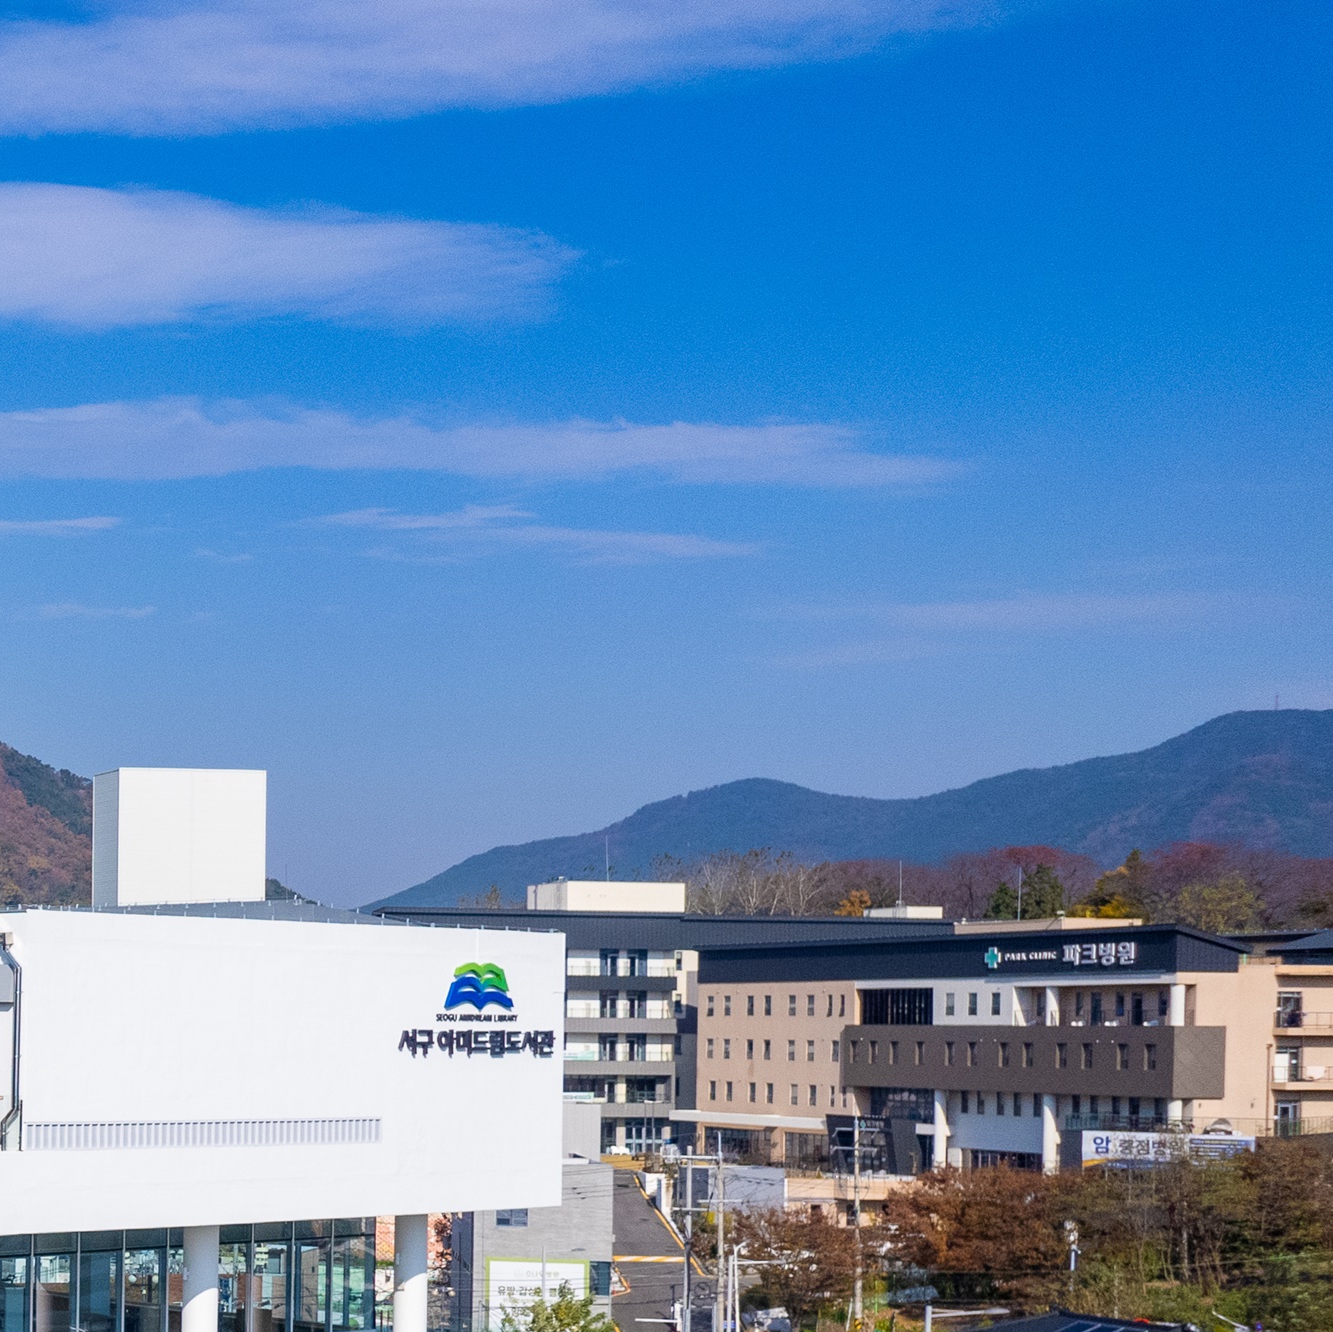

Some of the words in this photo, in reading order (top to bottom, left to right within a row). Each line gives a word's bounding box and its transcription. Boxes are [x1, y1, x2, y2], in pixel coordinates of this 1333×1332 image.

[1028, 951, 1057, 960] CLINIC
[1062, 941, 1135, 966] 파크병원
[436, 1013, 458, 1022] SEOGU
[398, 1029, 434, 1058] 서구
[1092, 1136, 1112, 1155] 암
